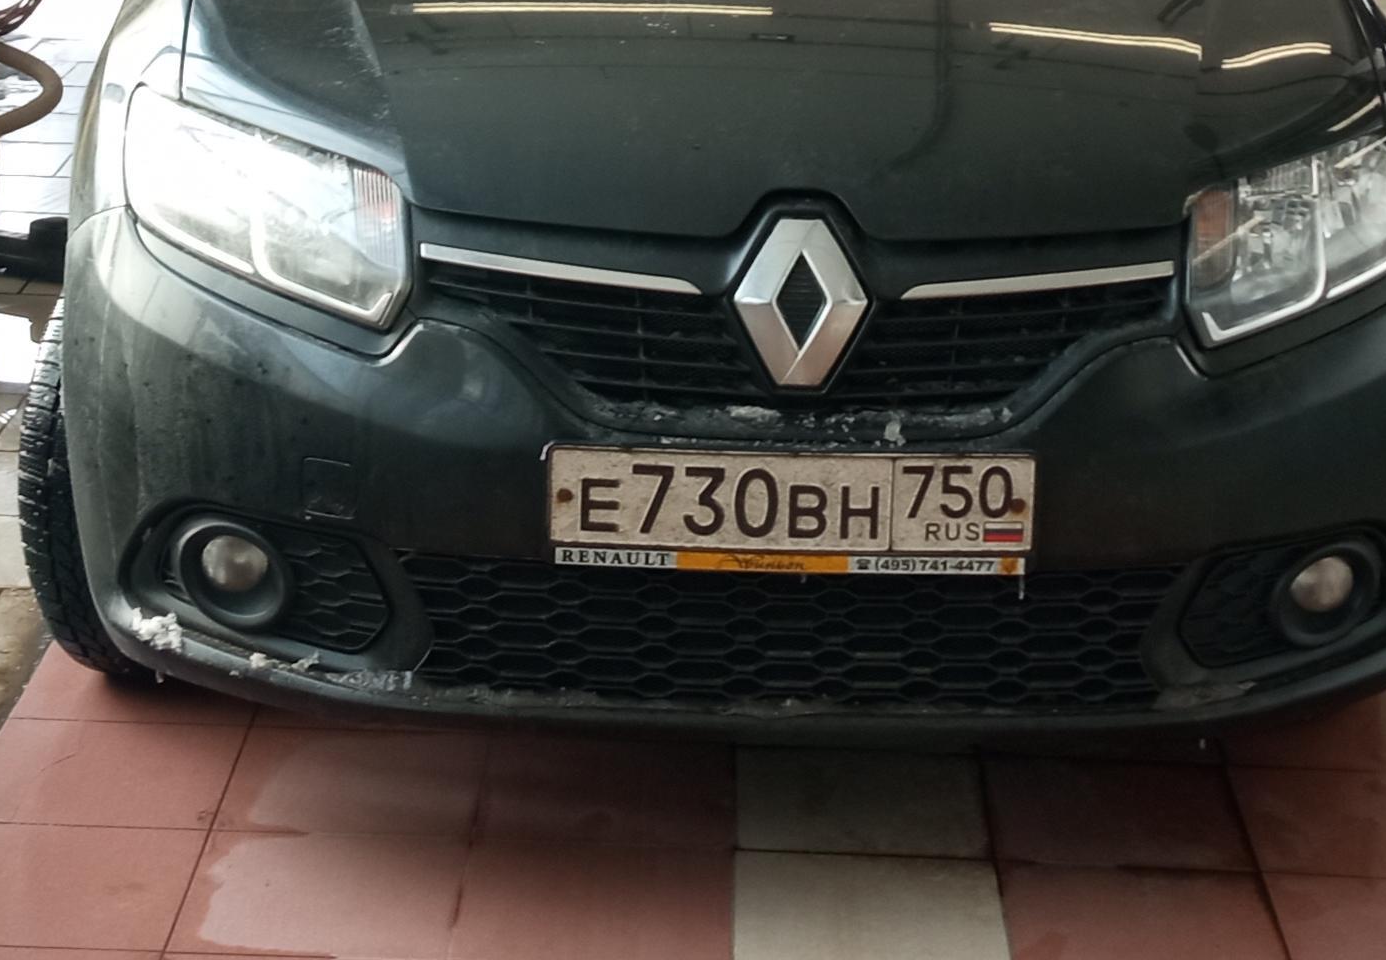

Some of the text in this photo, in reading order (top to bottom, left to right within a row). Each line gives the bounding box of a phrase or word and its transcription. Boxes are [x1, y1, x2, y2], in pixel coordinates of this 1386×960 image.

[901, 464, 1015, 519] 750
[924, 522, 980, 542] RUS
[562, 549, 671, 567] RENAULT
